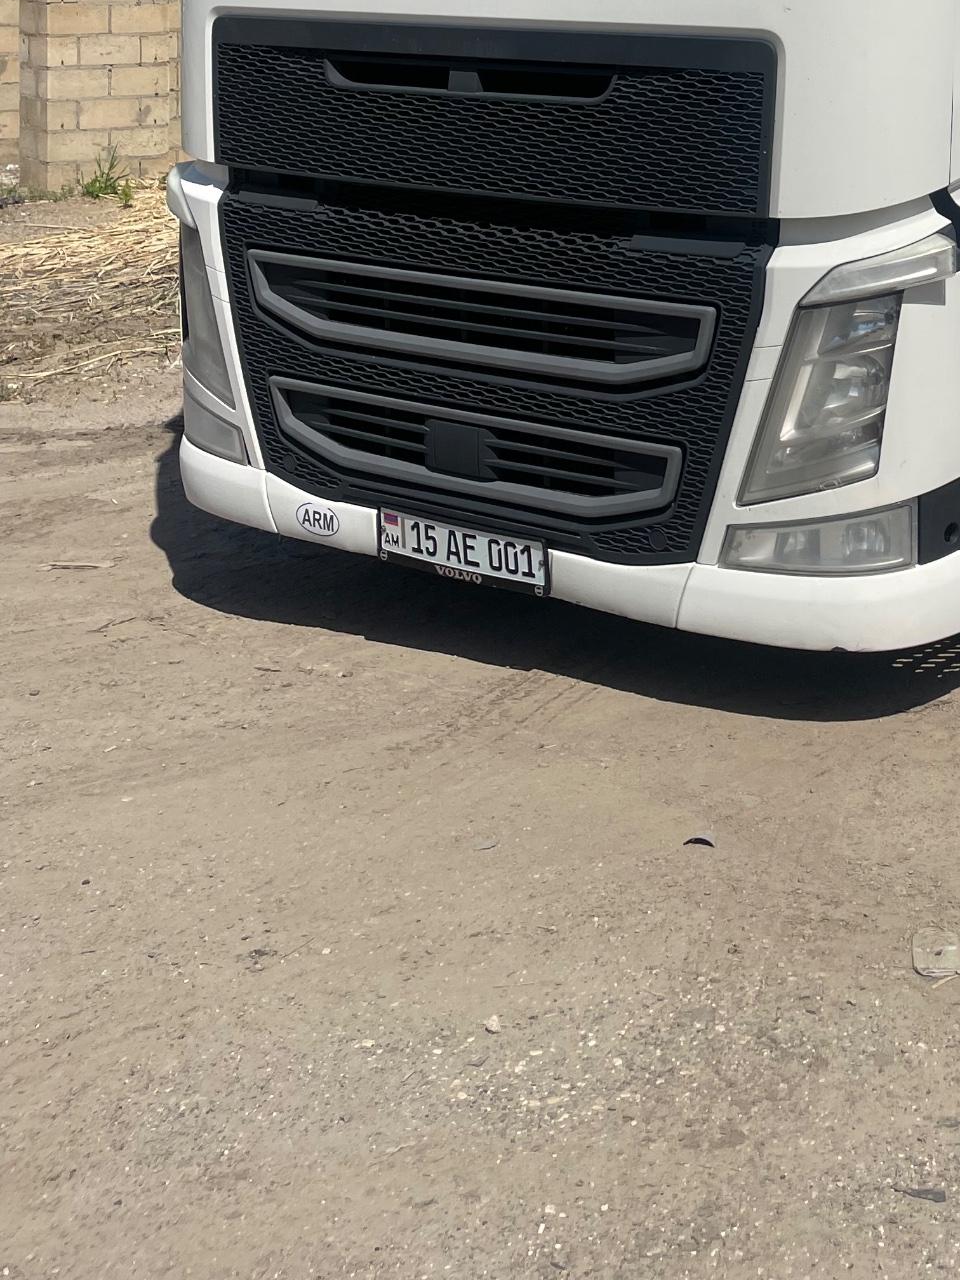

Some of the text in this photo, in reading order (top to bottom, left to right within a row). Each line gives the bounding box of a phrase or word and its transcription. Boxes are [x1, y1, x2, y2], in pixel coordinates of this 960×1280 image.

[302, 508, 335, 532] ARM
[384, 532, 400, 548] AM
[411, 521, 536, 579] 15 AE 001
[434, 564, 482, 585] VOLVO
